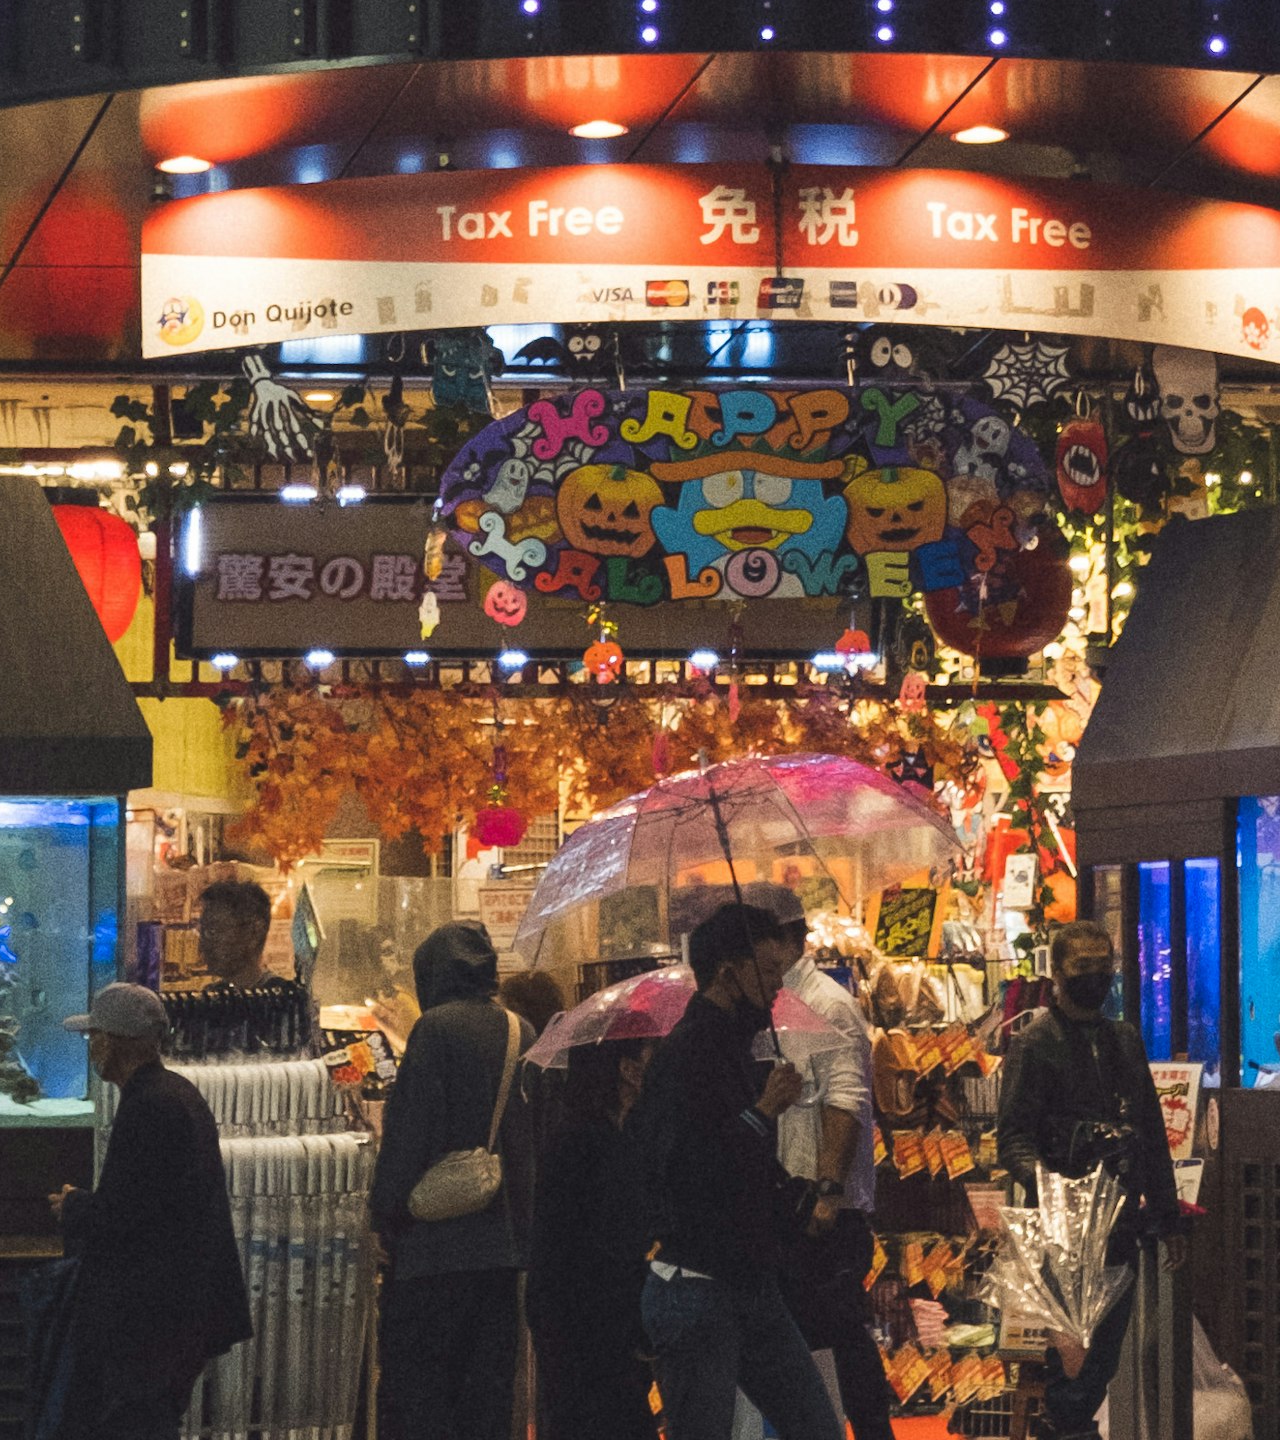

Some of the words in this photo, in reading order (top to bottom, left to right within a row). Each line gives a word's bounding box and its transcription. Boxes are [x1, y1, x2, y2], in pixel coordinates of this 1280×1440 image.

[436, 204, 514, 242] Tax
[528, 199, 625, 237] Free
[698, 183, 860, 249] 免税
[927, 201, 999, 243] Tax
[1011, 206, 1092, 251] Free
[212, 309, 256, 330] Don
[266, 297, 355, 326] Quijote
[592, 286, 634, 303] VISA
[527, 386, 920, 462] HAPPY
[216, 553, 469, 603] 驚安の殿堂
[469, 505, 1018, 608] HALLOWEEN
